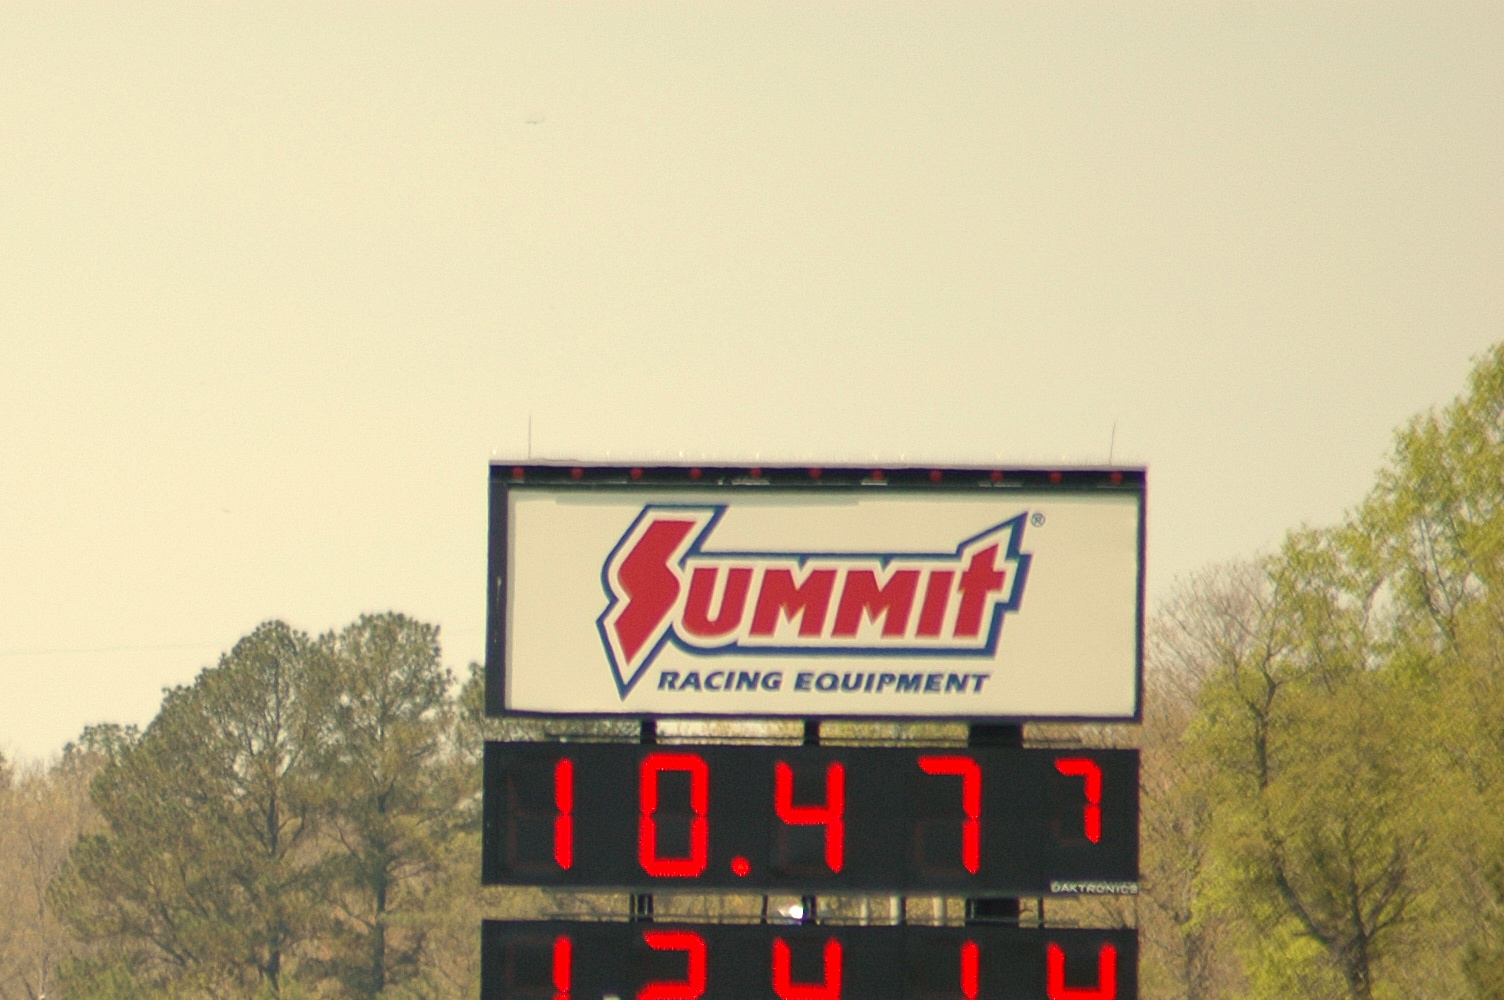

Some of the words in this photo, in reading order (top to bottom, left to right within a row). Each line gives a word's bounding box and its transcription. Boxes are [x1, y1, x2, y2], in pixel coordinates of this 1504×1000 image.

[657, 671, 783, 691] RACING
[794, 673, 990, 693] EQUIPMENT
[1050, 881, 1138, 894] DAKTRONICS
